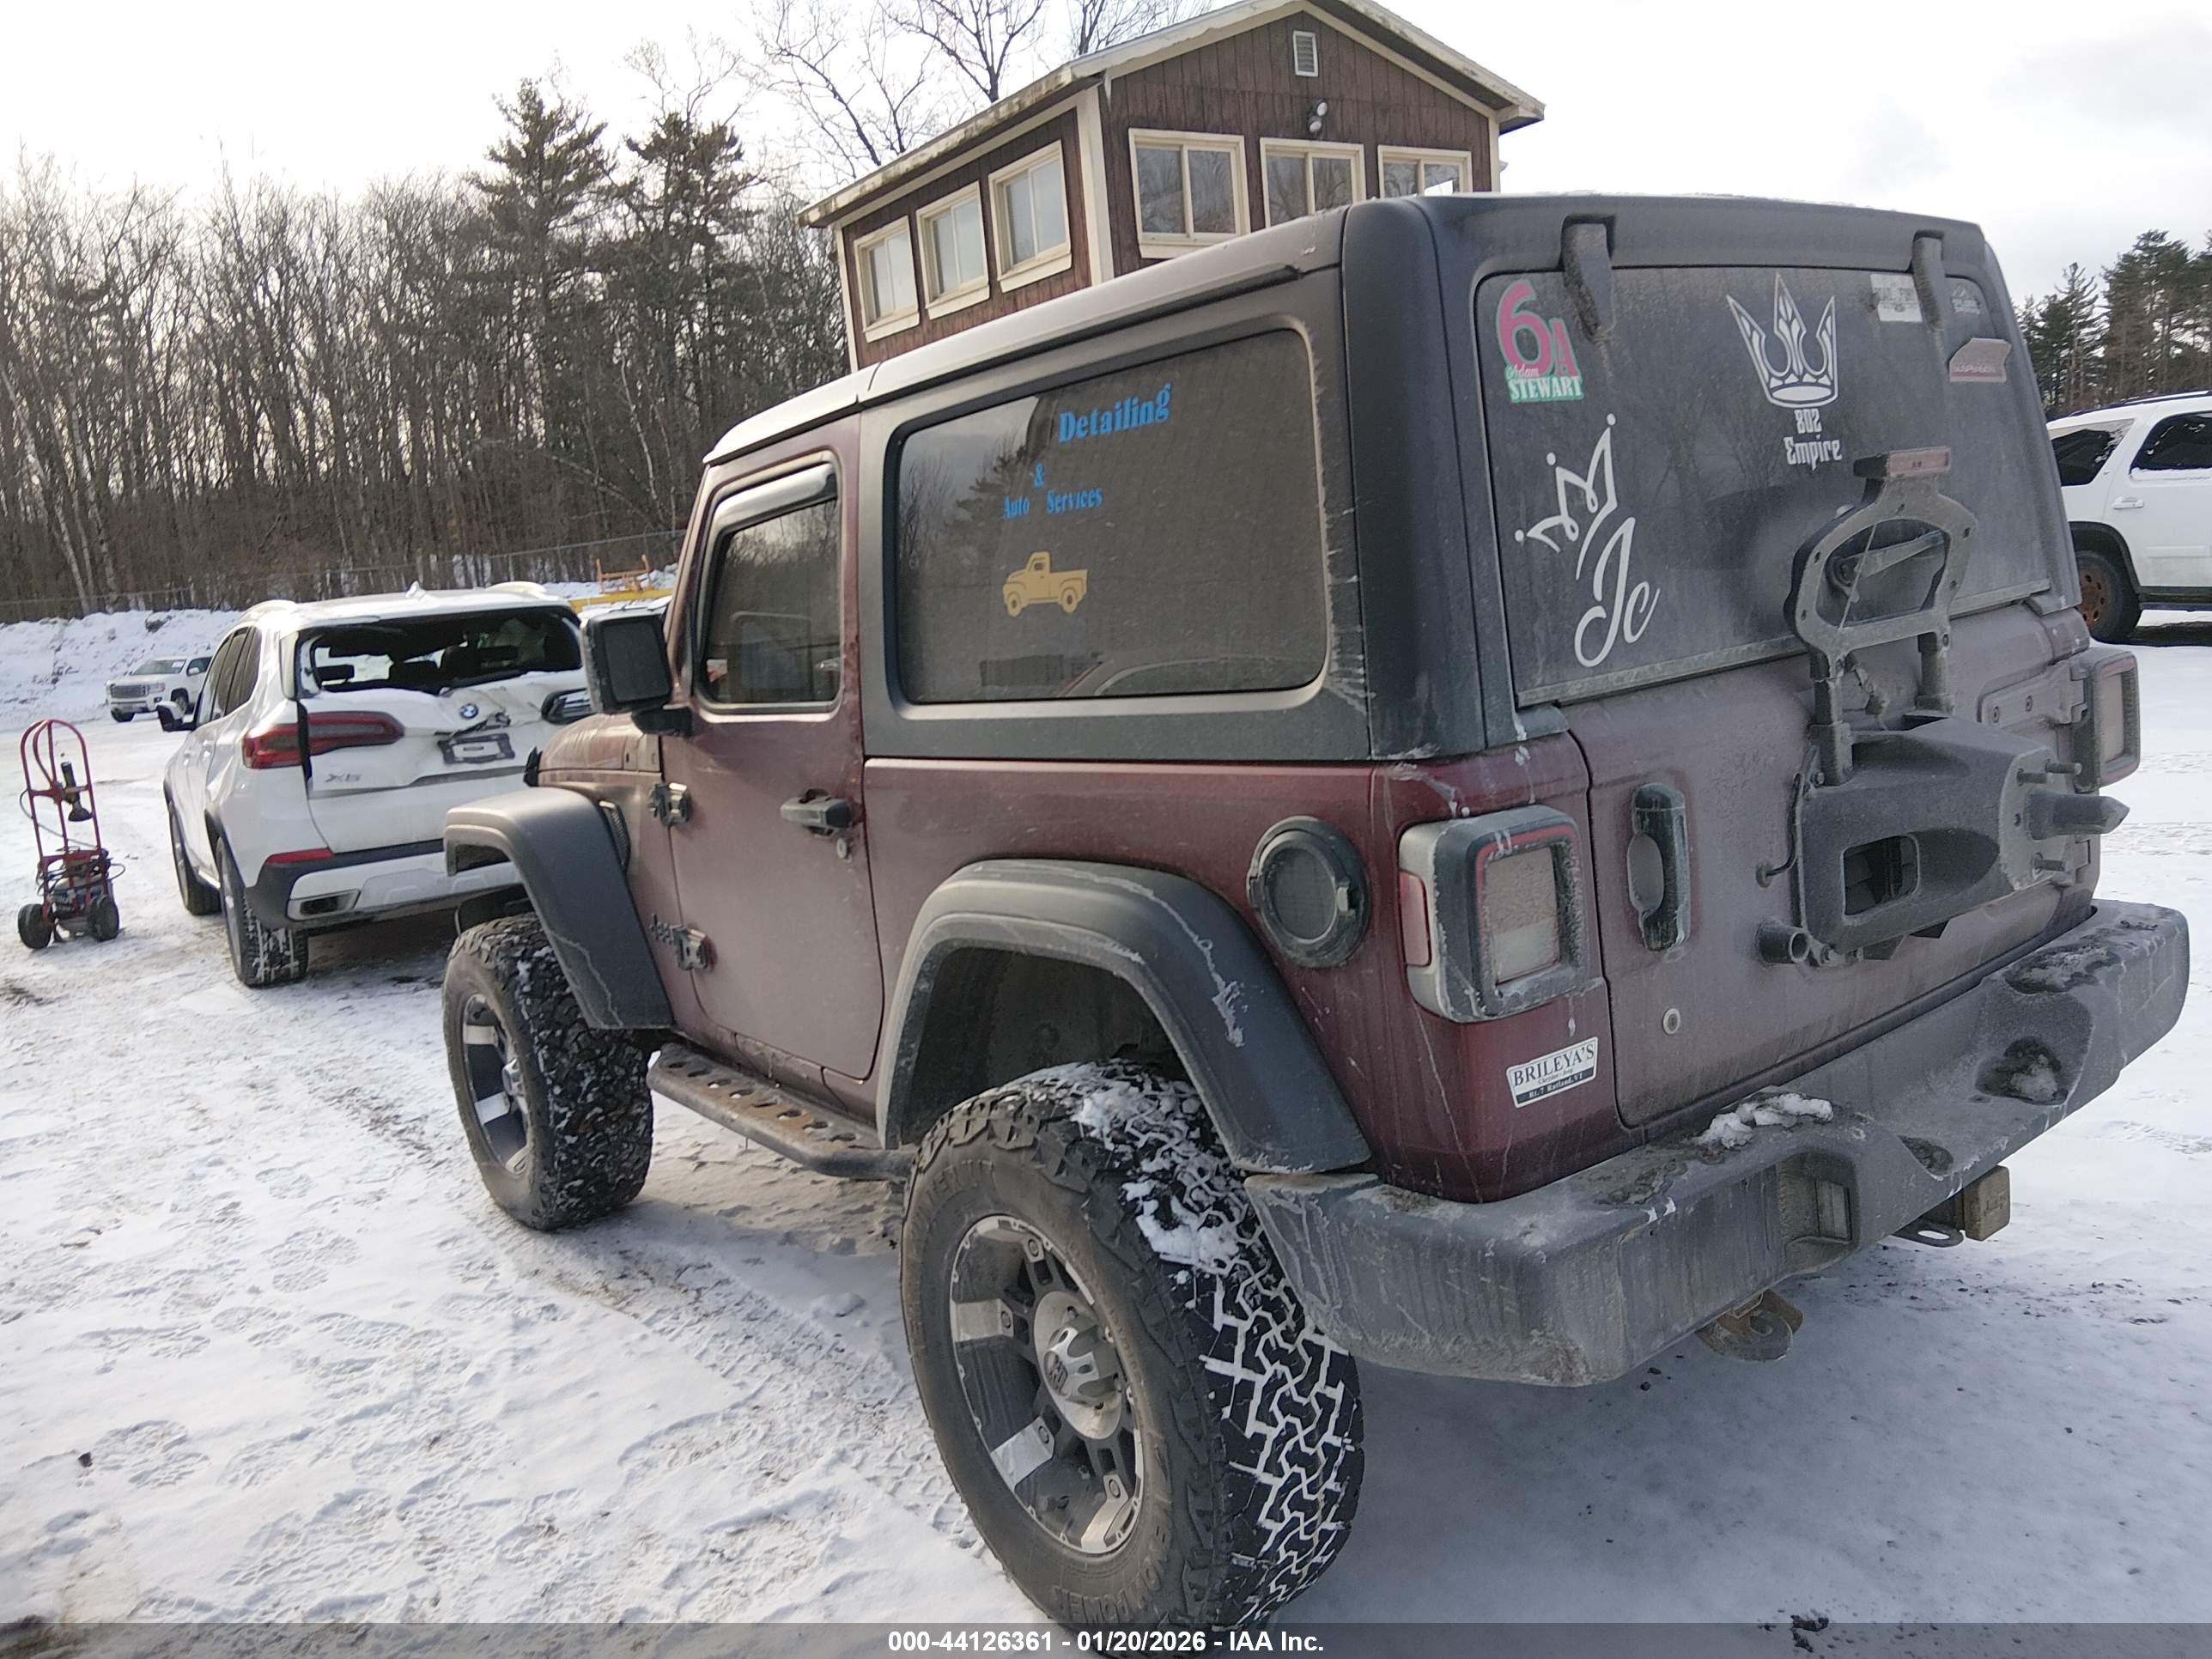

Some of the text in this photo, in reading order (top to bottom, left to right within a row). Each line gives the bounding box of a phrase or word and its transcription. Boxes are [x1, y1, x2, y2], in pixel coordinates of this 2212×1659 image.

[1508, 375, 1583, 401] STEWART
[1059, 384, 1172, 443] Detailing
[1794, 408, 1822, 434] 802
[1784, 434, 1843, 471] Empire
[1034, 464, 1044, 487] &
[1003, 487, 1104, 519] Auto Services
[1514, 1043, 1595, 1086] BRILEYA'S
